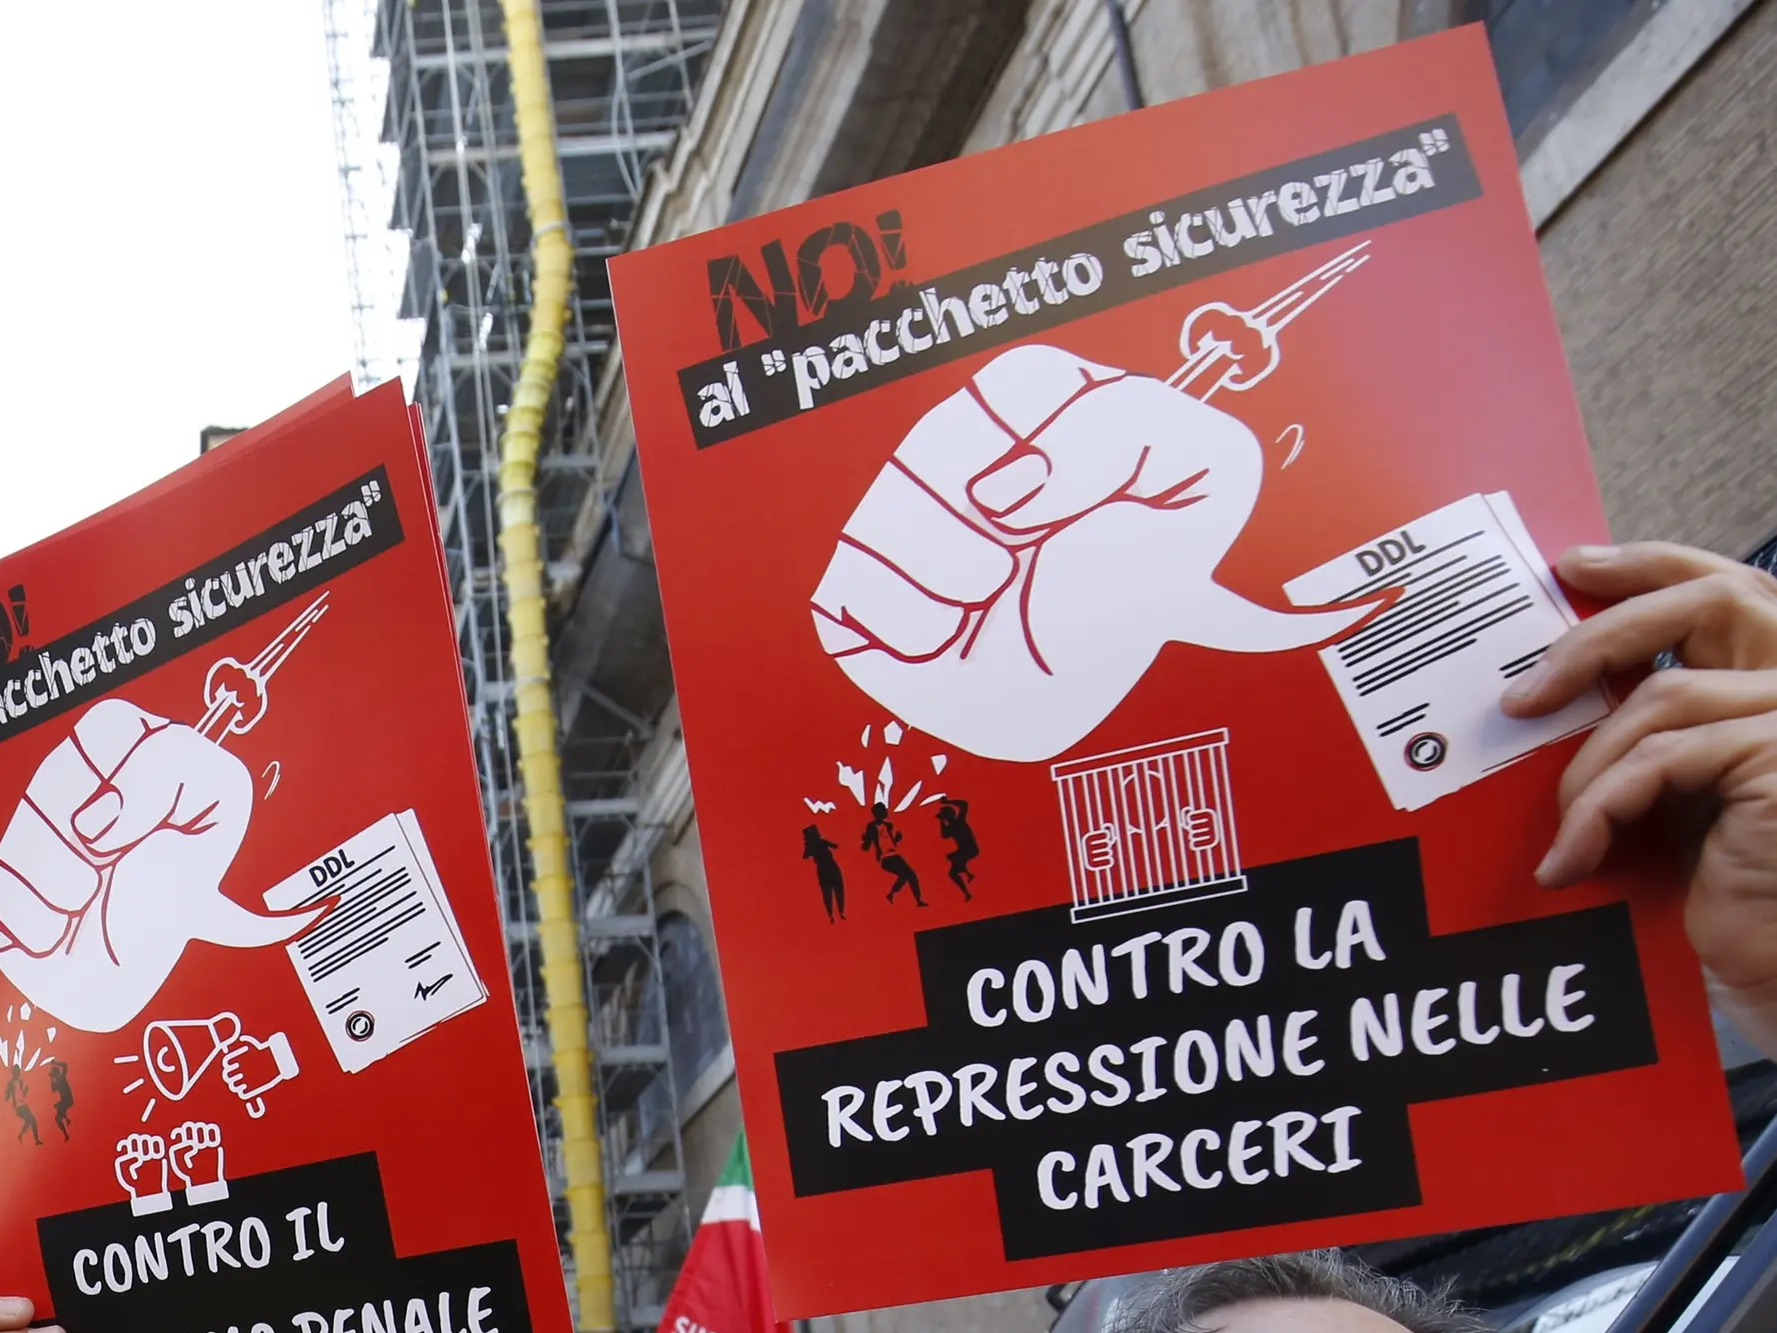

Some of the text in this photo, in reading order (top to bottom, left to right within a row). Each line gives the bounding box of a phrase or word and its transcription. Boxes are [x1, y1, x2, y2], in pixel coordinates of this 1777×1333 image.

[697, 127, 1451, 428] al "pacchetto sicurezza"
[707, 209, 914, 353] NO!
[168, 480, 382, 638] sicurezza"
[1355, 531, 1426, 577] DDL
[308, 849, 356, 888] DDL
[966, 899, 1386, 1028] CONTRO LA
[820, 963, 1595, 1148] REPRESSIONE NELLE
[1036, 1105, 1362, 1210] CARCERI
[73, 1201, 345, 1296] CONTRO IL
